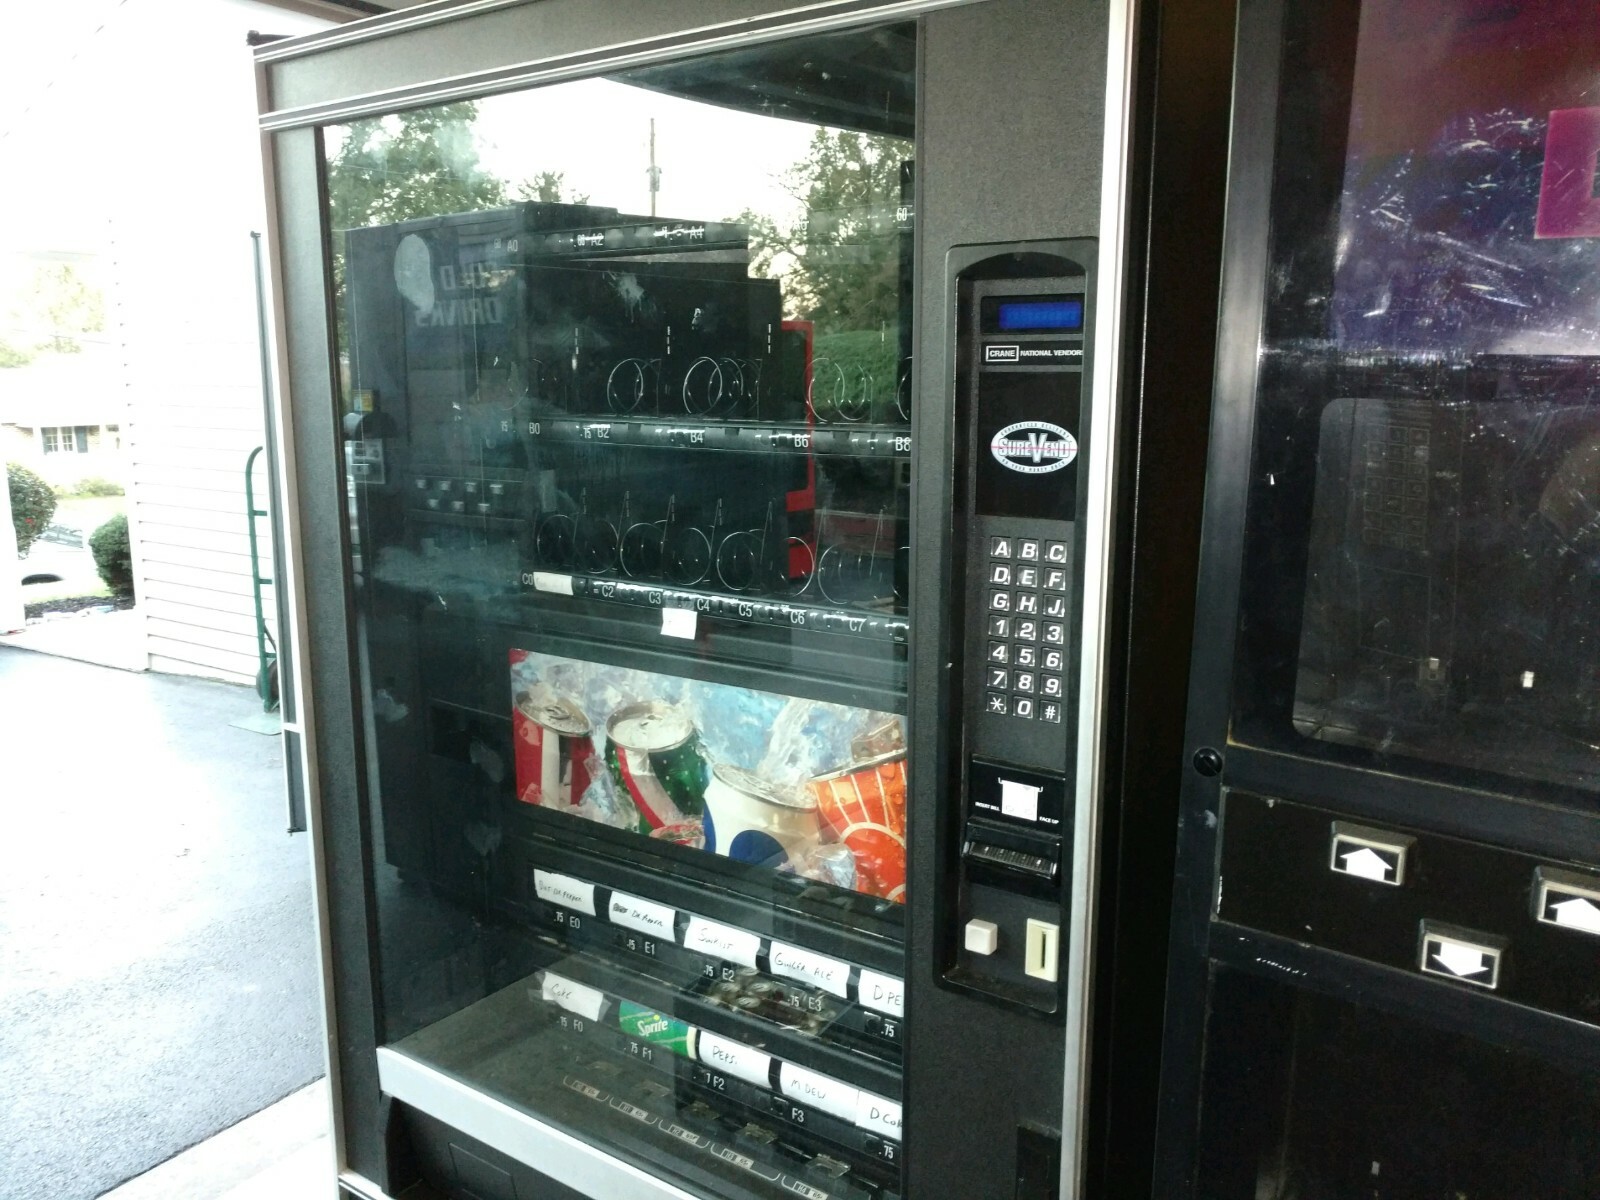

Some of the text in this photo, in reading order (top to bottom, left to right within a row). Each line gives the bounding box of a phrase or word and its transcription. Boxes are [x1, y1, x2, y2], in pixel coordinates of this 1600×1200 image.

[590, 233, 603, 246] A2
[690, 226, 703, 239] A4
[507, 240, 518, 252] A0
[1020, 349, 1053, 357] NATIONAL
[528, 422, 541, 435] B0
[597, 426, 609, 439] B2
[690, 430, 704, 444] B4
[794, 434, 809, 449] B6
[994, 541, 1064, 561] A B C
[521, 573, 534, 586] C0
[993, 567, 1062, 587] D E F
[601, 585, 615, 598] C2
[648, 591, 662, 605] C3
[697, 598, 710, 612] C4
[738, 603, 753, 618] C5
[993, 593, 1061, 615] G H J
[790, 610, 805, 625] C6
[849, 618, 865, 632] C7
[995, 619, 1061, 641] 1 2 3
[992, 645, 1060, 668] 4 5 6
[993, 671, 1059, 694] 7 8 9
[1017, 700, 1031, 716] 0
[1045, 705, 1056, 720] #
[569, 916, 581, 929] E0
[644, 941, 655, 955] E1
[722, 968, 735, 983] E2
[873, 984, 884, 1001] D
[808, 997, 822, 1012] E3
[573, 1019, 584, 1032] F0
[637, 1016, 669, 1037] Sprite
[642, 1047, 652, 1060] F1
[713, 1075, 725, 1091] F2
[791, 1107, 805, 1123] F3
[869, 1106, 880, 1120] D
